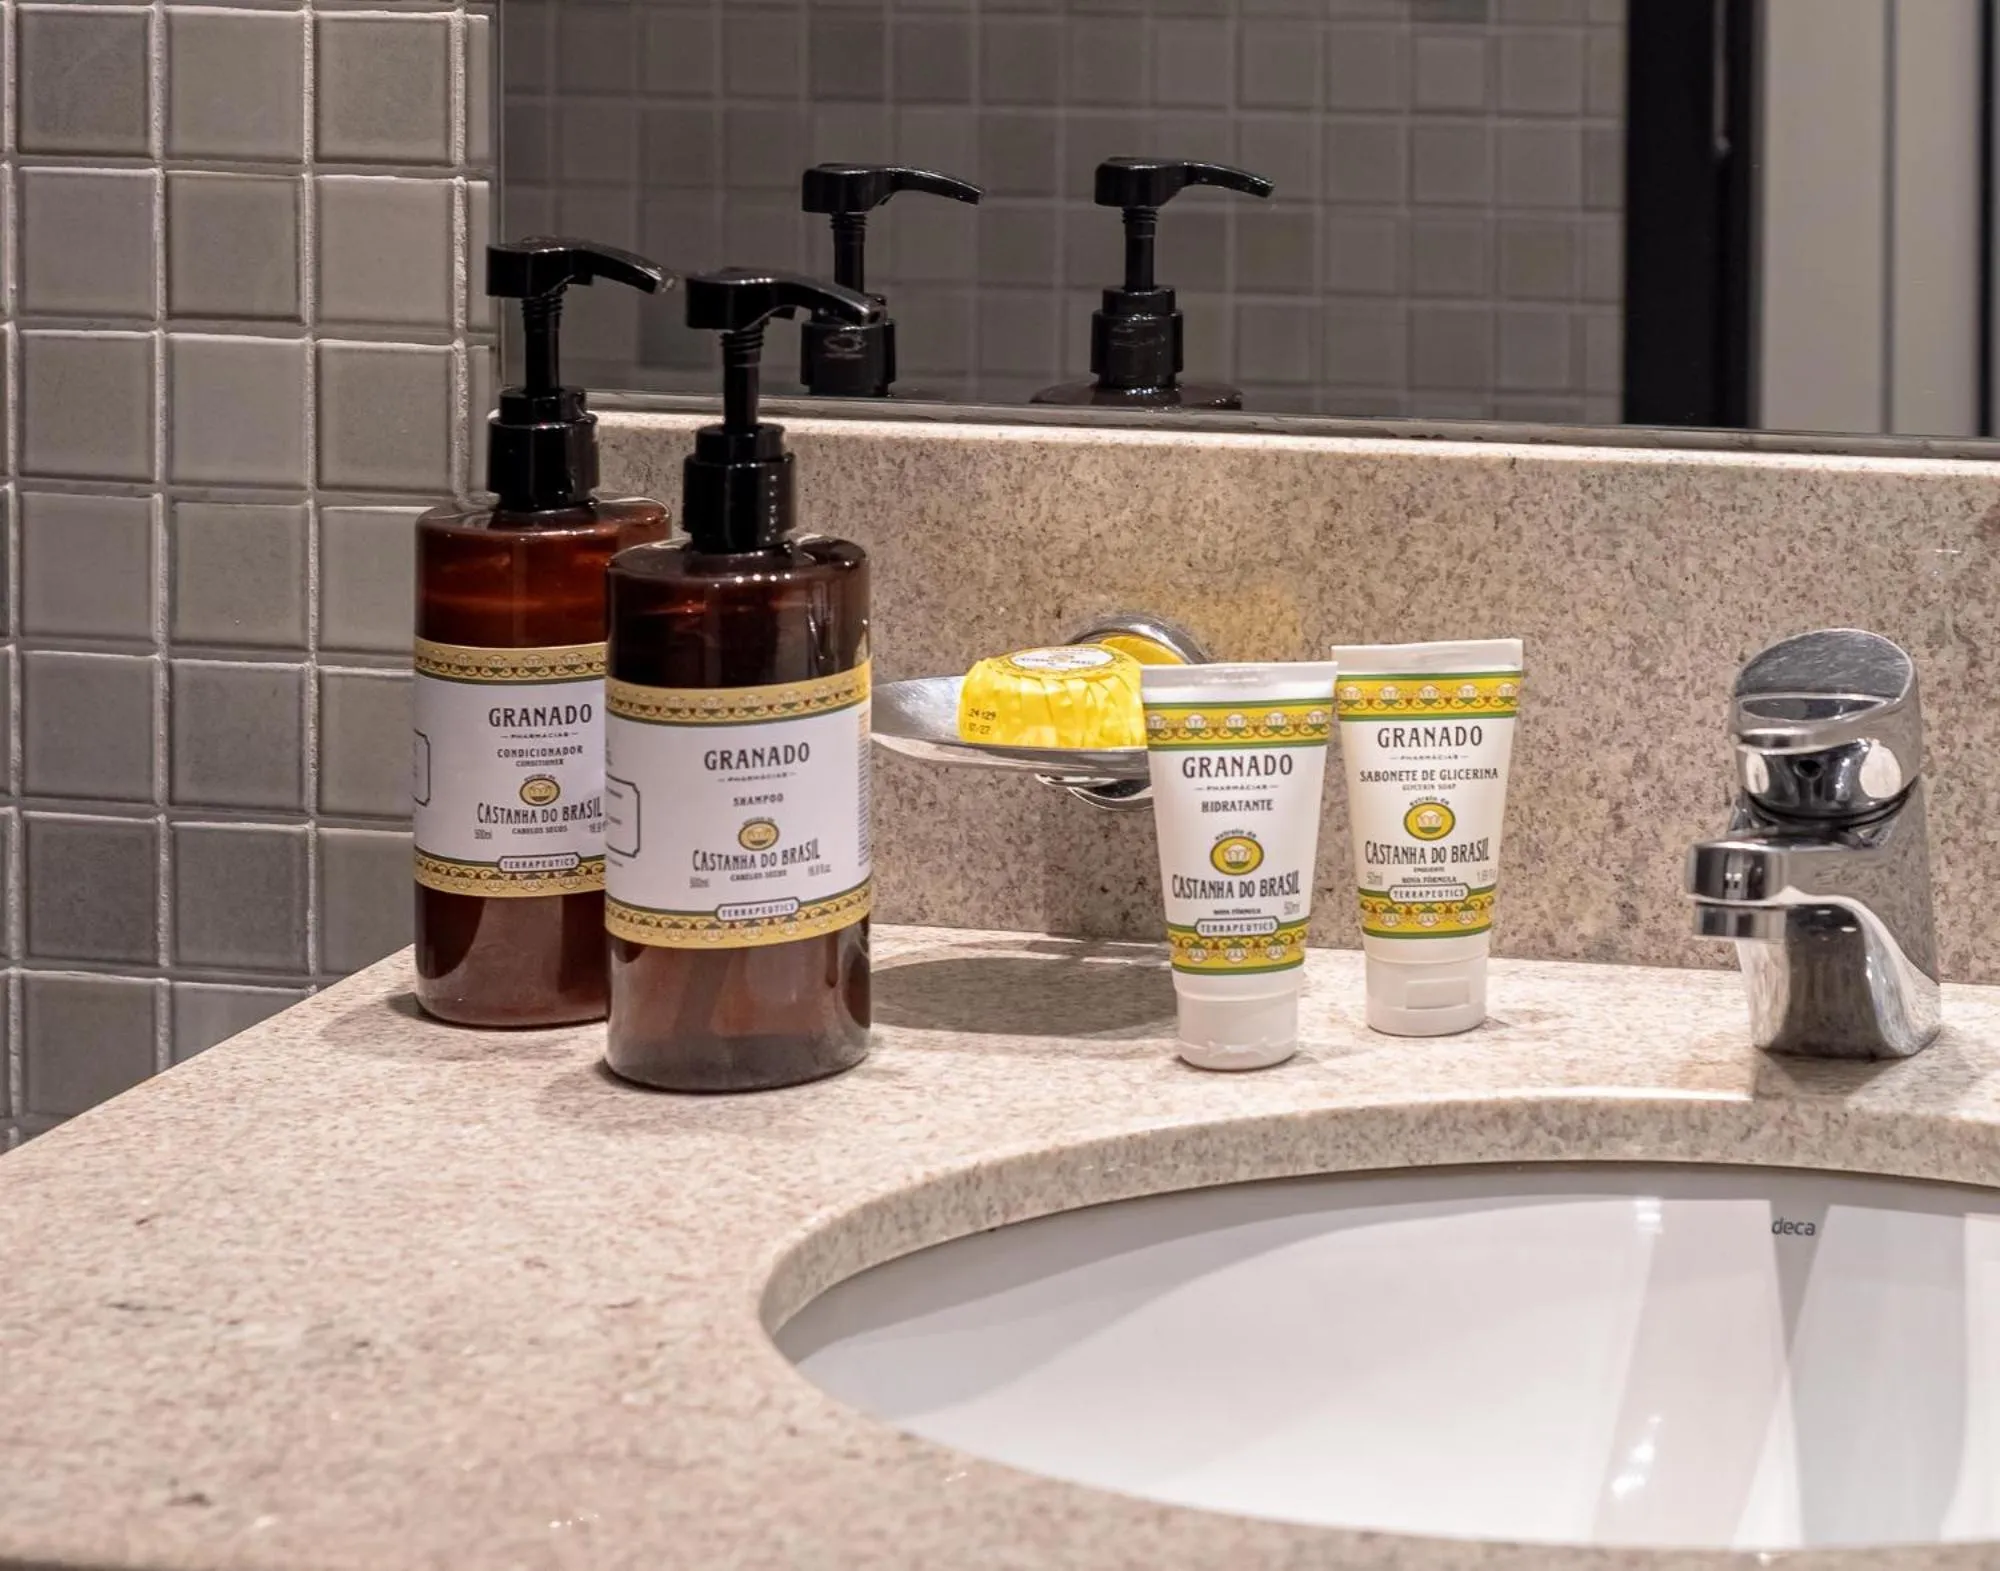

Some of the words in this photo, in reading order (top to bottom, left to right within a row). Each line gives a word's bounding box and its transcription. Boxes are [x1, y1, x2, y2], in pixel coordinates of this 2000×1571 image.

[488, 703, 593, 728] GRANADO
[1377, 725, 1483, 749] GRANADO
[497, 744, 584, 758] CONDICIONADOR
[703, 741, 810, 771] GRANADO
[1182, 753, 1294, 779] GRANADO
[1359, 769, 1418, 782] SABONETE
[1421, 769, 1436, 781] DE
[1439, 767, 1499, 781] GLICERINA
[732, 792, 785, 807] SHAMPOO
[1201, 799, 1274, 813] HIDRATANTE
[477, 802, 537, 825] CASTANHA
[541, 808, 558, 823] DO
[562, 797, 603, 821] BRASIL
[692, 849, 757, 872] CASTANHA
[760, 852, 778, 869] DO
[781, 838, 821, 866] BRASIL
[1365, 840, 1427, 865] CASTANHA
[1431, 846, 1448, 864] DO
[1451, 837, 1490, 863] BRASIL
[503, 857, 576, 869] TERRAPEUTICS
[1172, 874, 1235, 900] CASTANHA
[1239, 880, 1256, 898] DO
[1260, 869, 1300, 898] BRASIL
[1394, 889, 1465, 898] TERRAPEUTICS
[721, 902, 796, 918] TERRAPEUTICS
[1200, 922, 1274, 933] TERRAPEUTICS
[1771, 1216, 1817, 1236] deca
